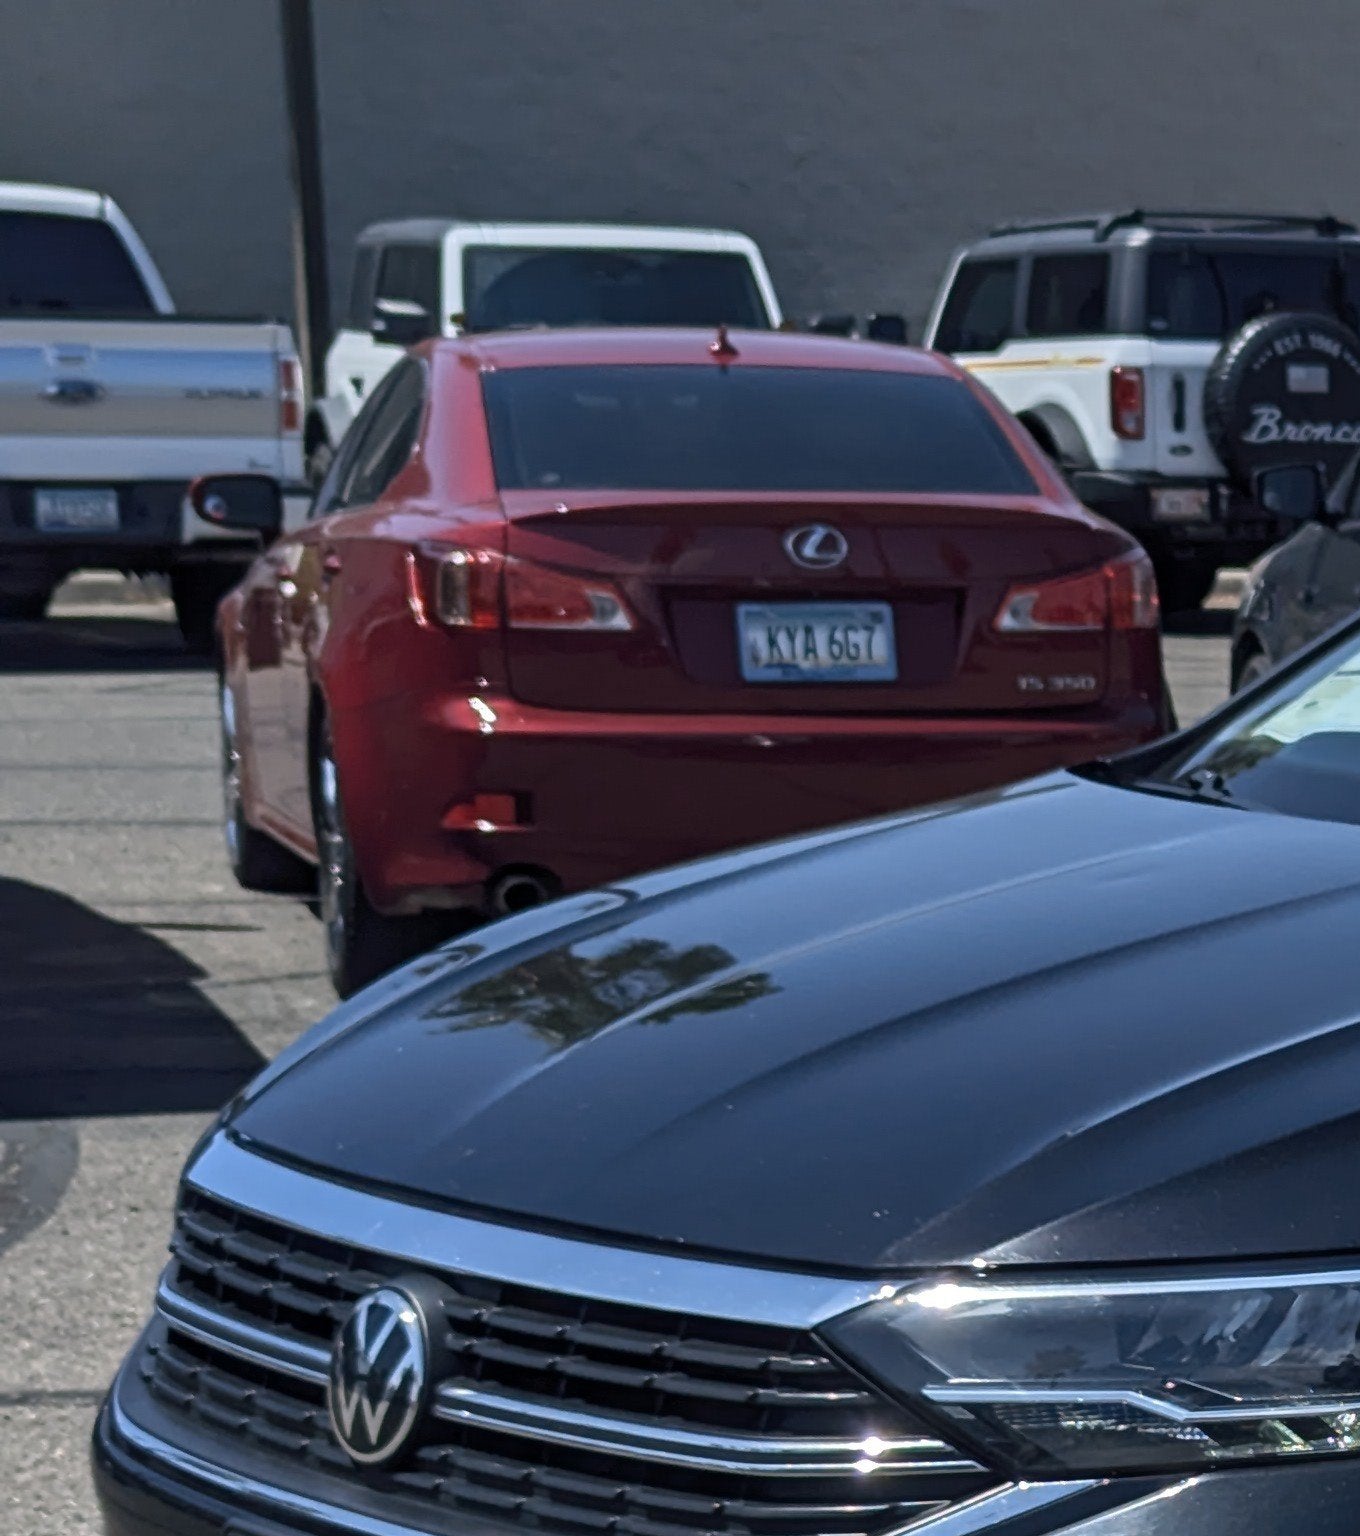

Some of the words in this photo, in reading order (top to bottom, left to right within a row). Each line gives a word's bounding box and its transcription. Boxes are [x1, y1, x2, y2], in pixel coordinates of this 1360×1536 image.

[767, 625, 819, 660] KYA
[1016, 674, 1044, 690] IS
[1047, 674, 1096, 690] 350
